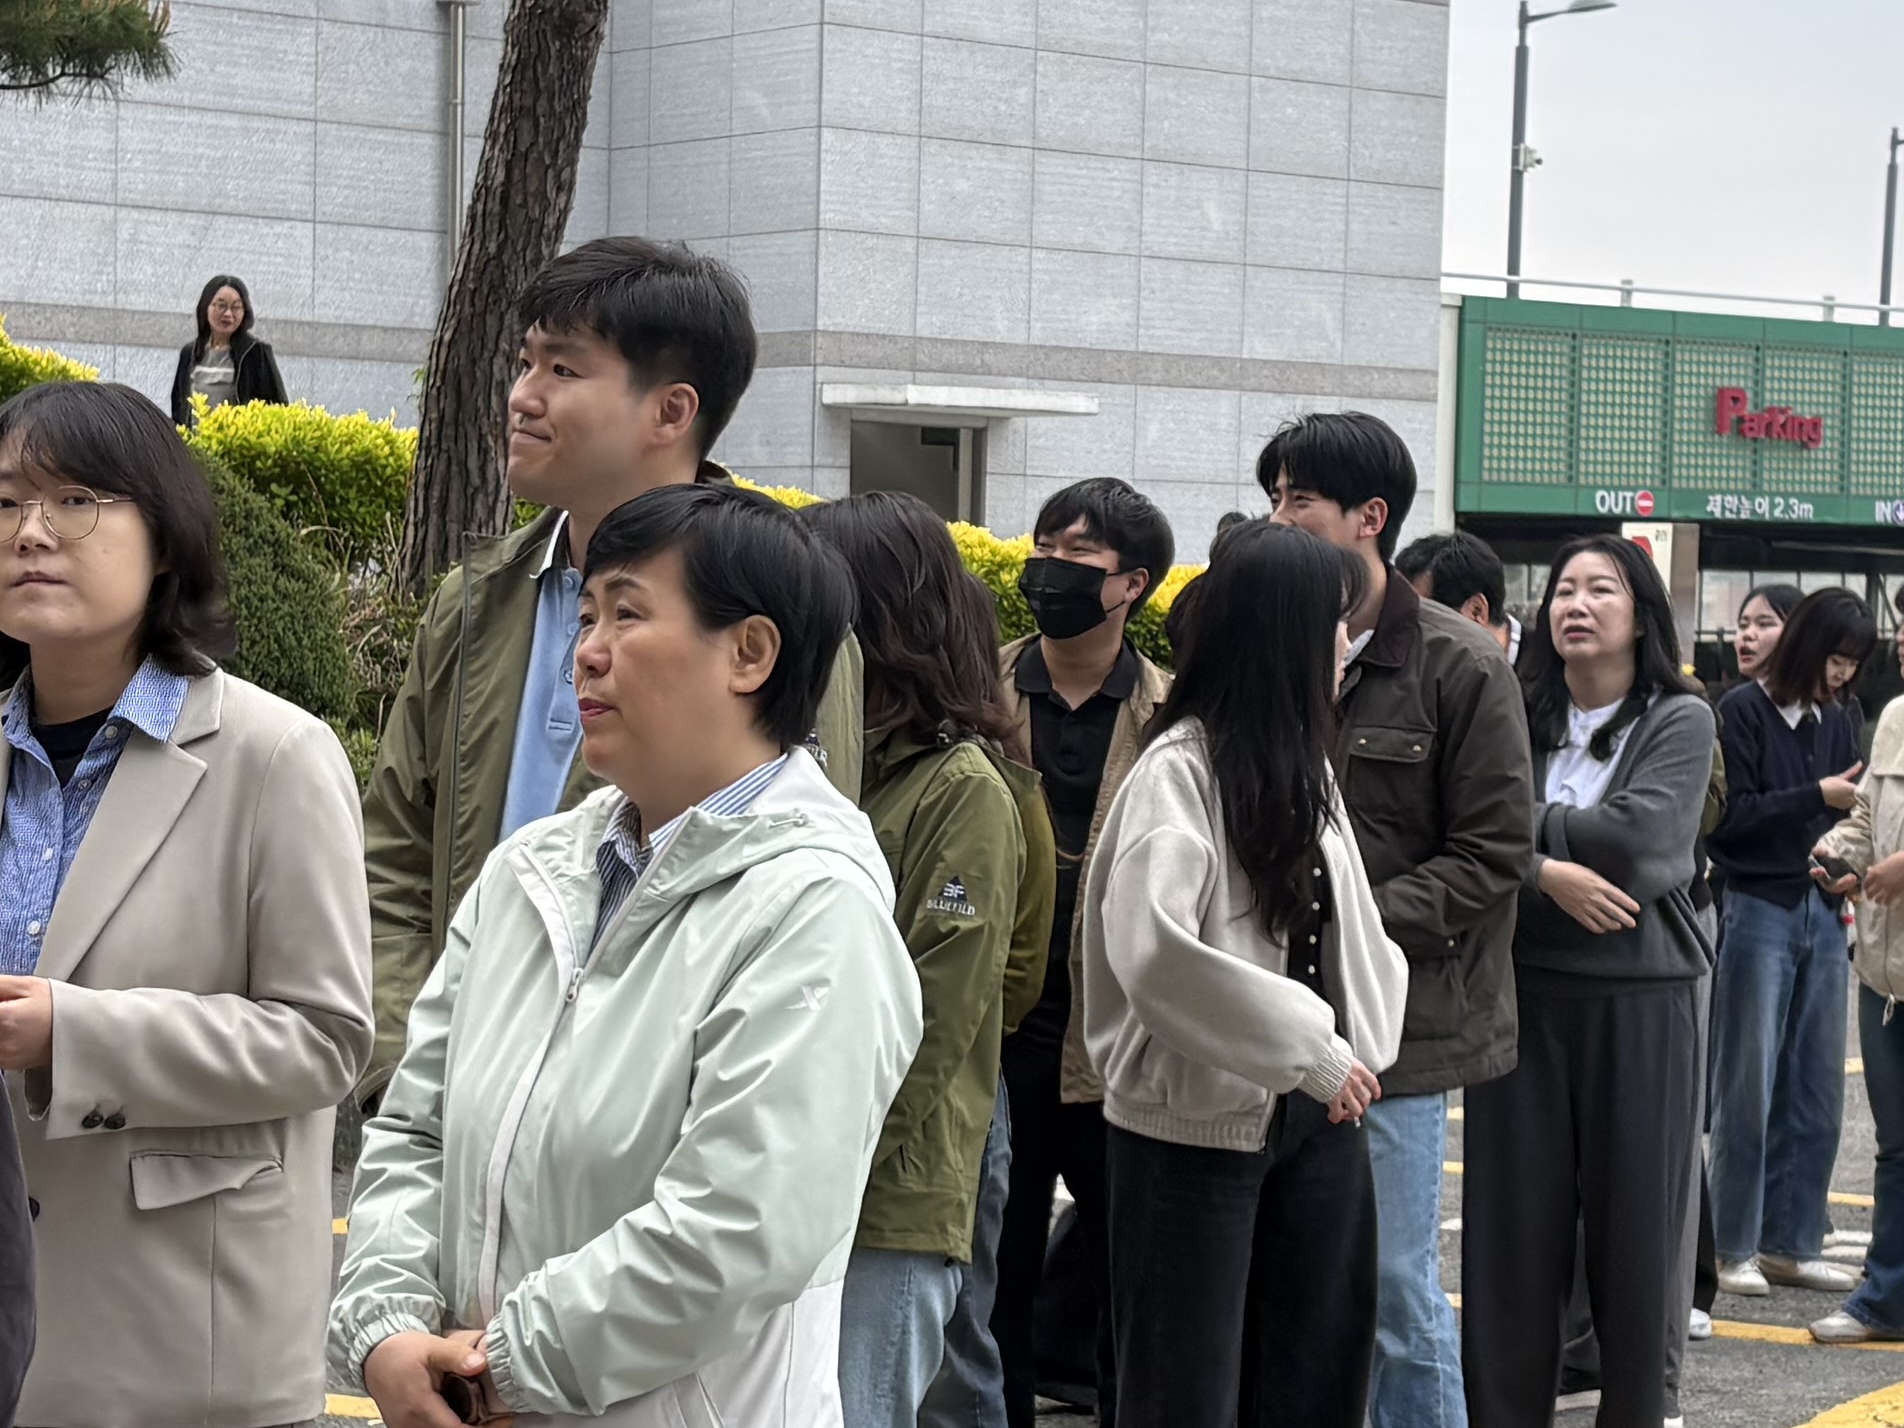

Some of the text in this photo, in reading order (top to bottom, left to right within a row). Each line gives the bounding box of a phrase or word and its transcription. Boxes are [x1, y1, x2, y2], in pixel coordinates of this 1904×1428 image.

[1715, 386, 1824, 449] Parking
[1595, 489, 1634, 514] OUT
[1706, 493, 1814, 520] 제한높이 2.3m
[1875, 500, 1892, 522] IN
